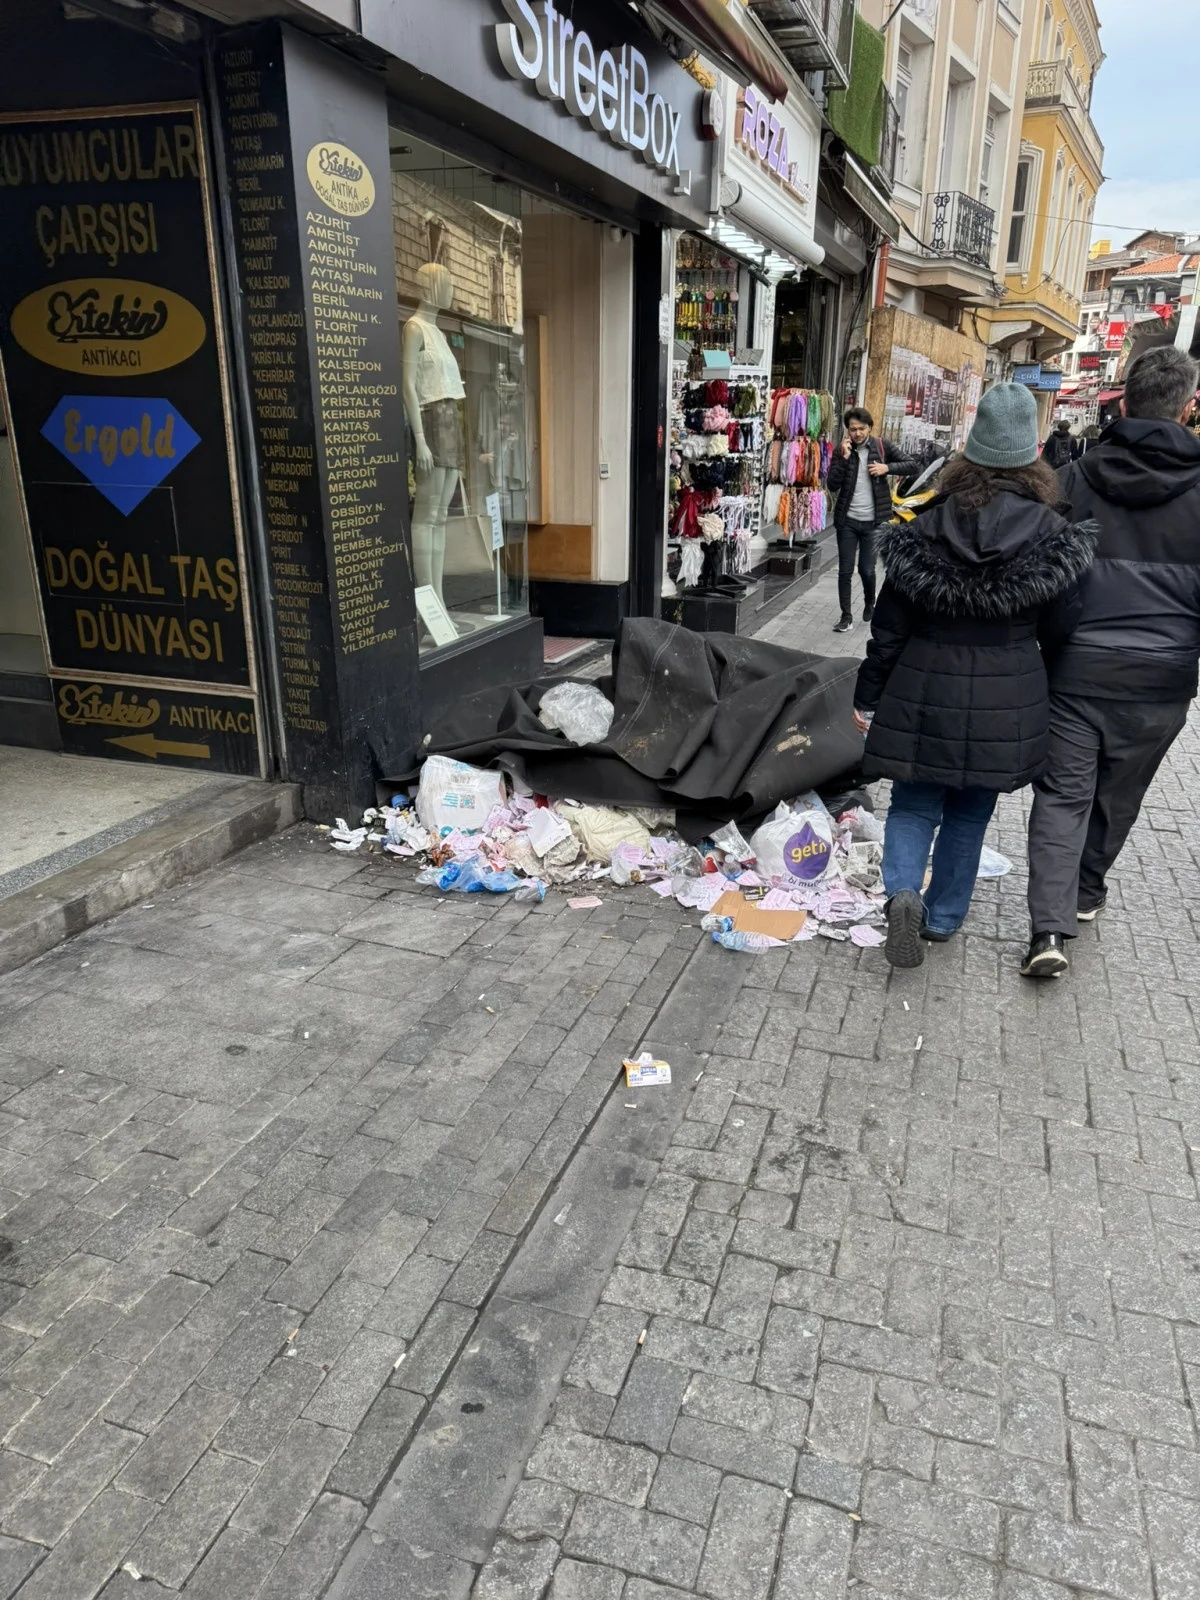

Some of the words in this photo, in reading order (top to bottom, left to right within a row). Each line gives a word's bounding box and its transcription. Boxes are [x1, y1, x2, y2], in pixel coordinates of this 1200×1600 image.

[495, 0, 682, 176] StreetBox
[742, 86, 789, 183] ROZA
[319, 147, 363, 182] Ertekin
[331, 180, 359, 201] ANTİKA
[306, 211, 351, 231] AZURİT
[35, 201, 159, 268] ÇARŞISI
[307, 225, 360, 246] AMETİST
[308, 239, 357, 258] AMONİT
[310, 253, 377, 276] AVENTURİN
[311, 266, 353, 284] AYTAŞI
[312, 280, 383, 300] AKUAMARİN
[313, 293, 350, 307] BERİL
[47, 288, 168, 344] Ertekin
[314, 306, 368, 322] DUMANLI
[315, 319, 358, 333] FLORİT
[316, 332, 367, 347] HAMATİT
[81, 346, 142, 368] ANTİKACI
[317, 346, 358, 358] HAVLİT
[318, 359, 382, 372] KALSEDON
[319, 371, 361, 382] KALSİT
[320, 384, 397, 395] KAPLANGÖZÜ
[322, 408, 382, 419] KEHRİBAR
[323, 421, 370, 432] KANTAŞ
[63, 408, 176, 467] Ergold
[324, 432, 383, 444] KRİZOKOL
[325, 443, 366, 457] KYANİT
[327, 456, 360, 469] LAPİS
[363, 451, 399, 465] LAZULİ
[328, 466, 376, 481] AFRODİT
[329, 479, 377, 493] MERCAN
[330, 493, 360, 505] OPAL
[332, 514, 380, 530] PERİDOT
[334, 538, 372, 554] PEMBE
[335, 542, 403, 566] RODOKROZİT
[44, 540, 165, 596] DOĞAL
[169, 555, 238, 612] TAŞ
[337, 572, 369, 588] RUTİL
[338, 579, 384, 600] SODALİT
[339, 599, 390, 622] TURKUAZ
[340, 614, 376, 632] YAKUT
[75, 603, 225, 663] DÜNYASI
[341, 625, 374, 644] YEŞİM
[342, 628, 397, 655] YILDIZTAŞI
[58, 684, 161, 728] Ertekin
[169, 705, 257, 735] ANTİKACI
